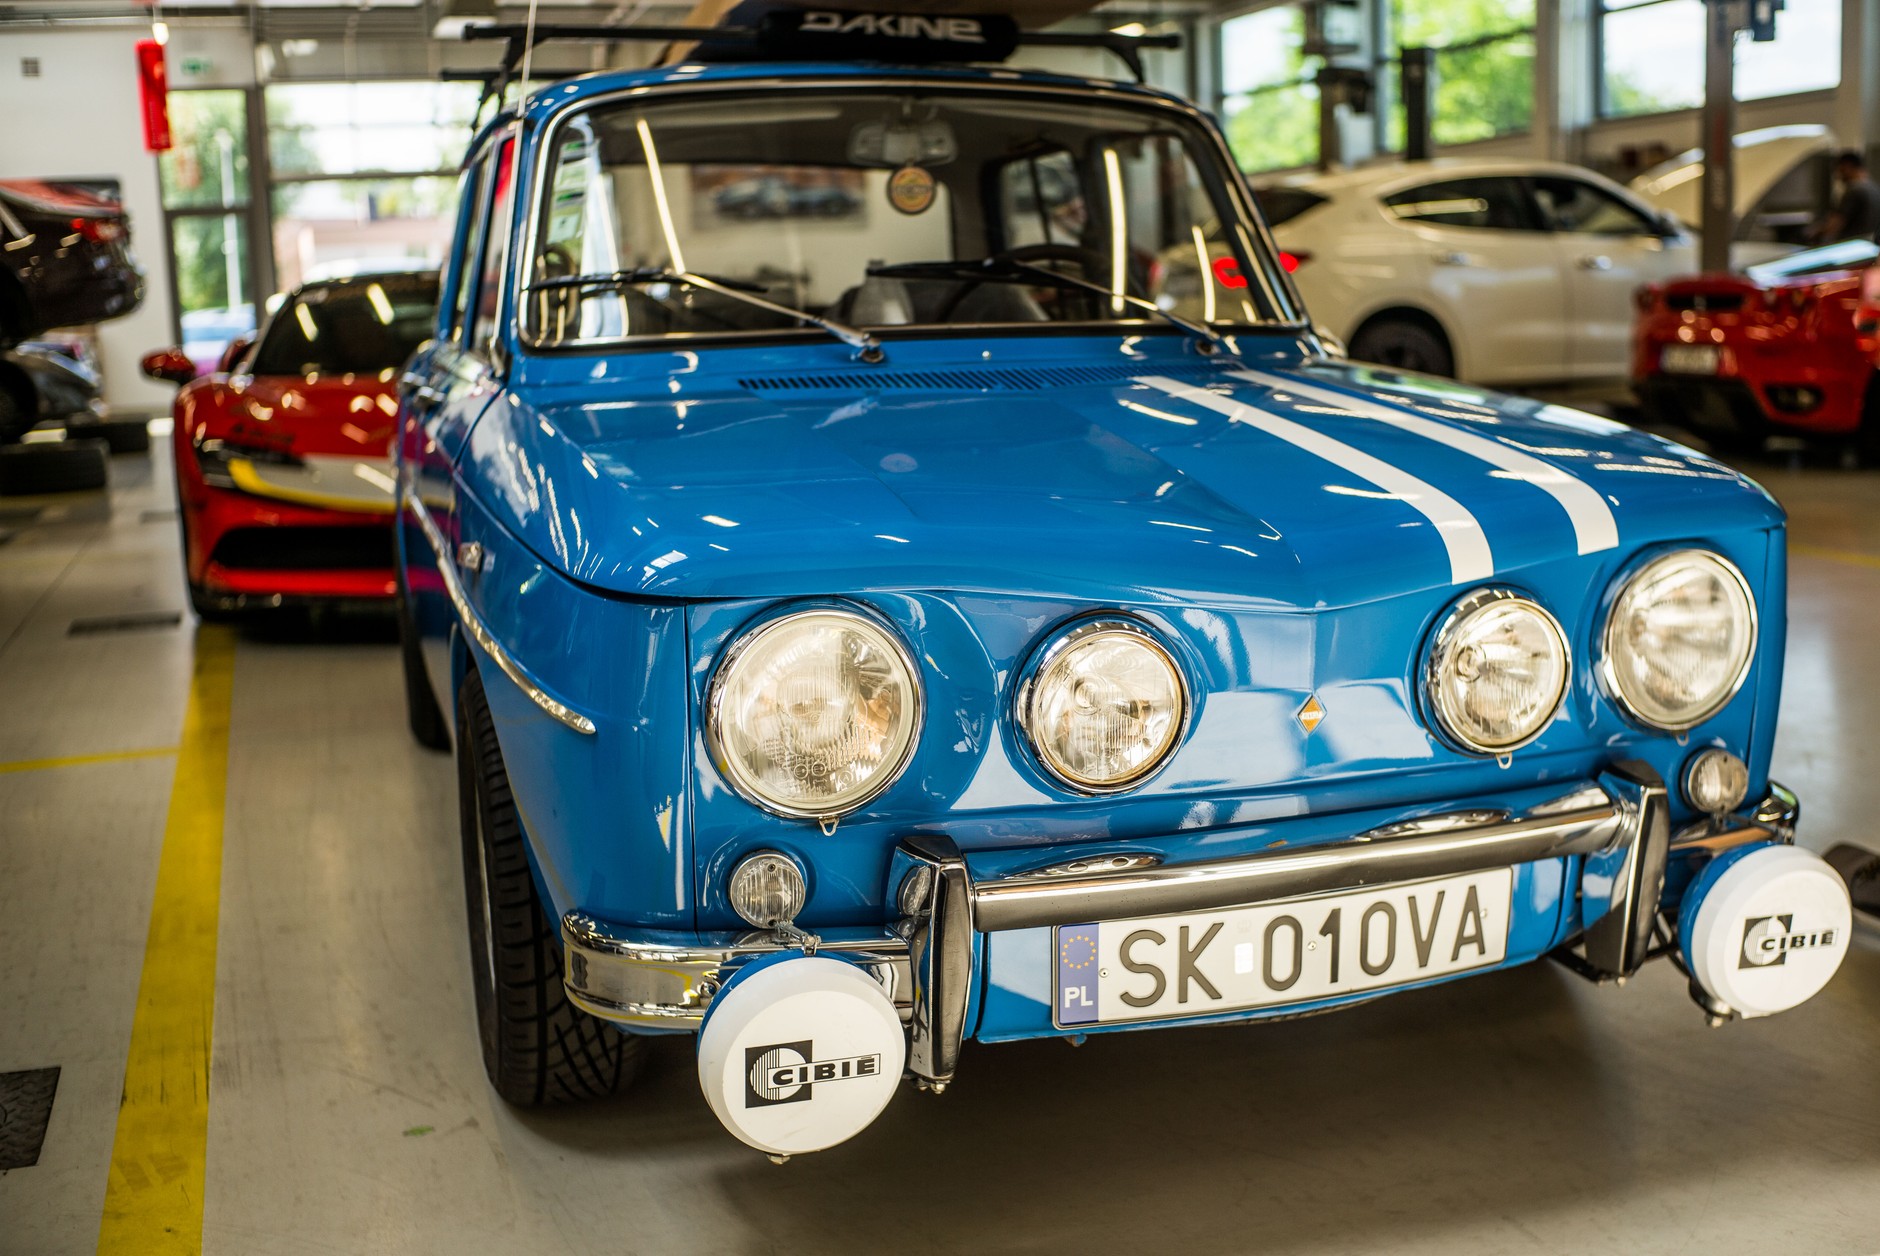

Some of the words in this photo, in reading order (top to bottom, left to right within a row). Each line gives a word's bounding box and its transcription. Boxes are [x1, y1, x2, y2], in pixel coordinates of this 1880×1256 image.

[799, 12, 986, 43] DAKINE
[1119, 922, 1224, 1007] SK
[1263, 885, 1486, 991] 010VA
[1064, 986, 1094, 1009] PL
